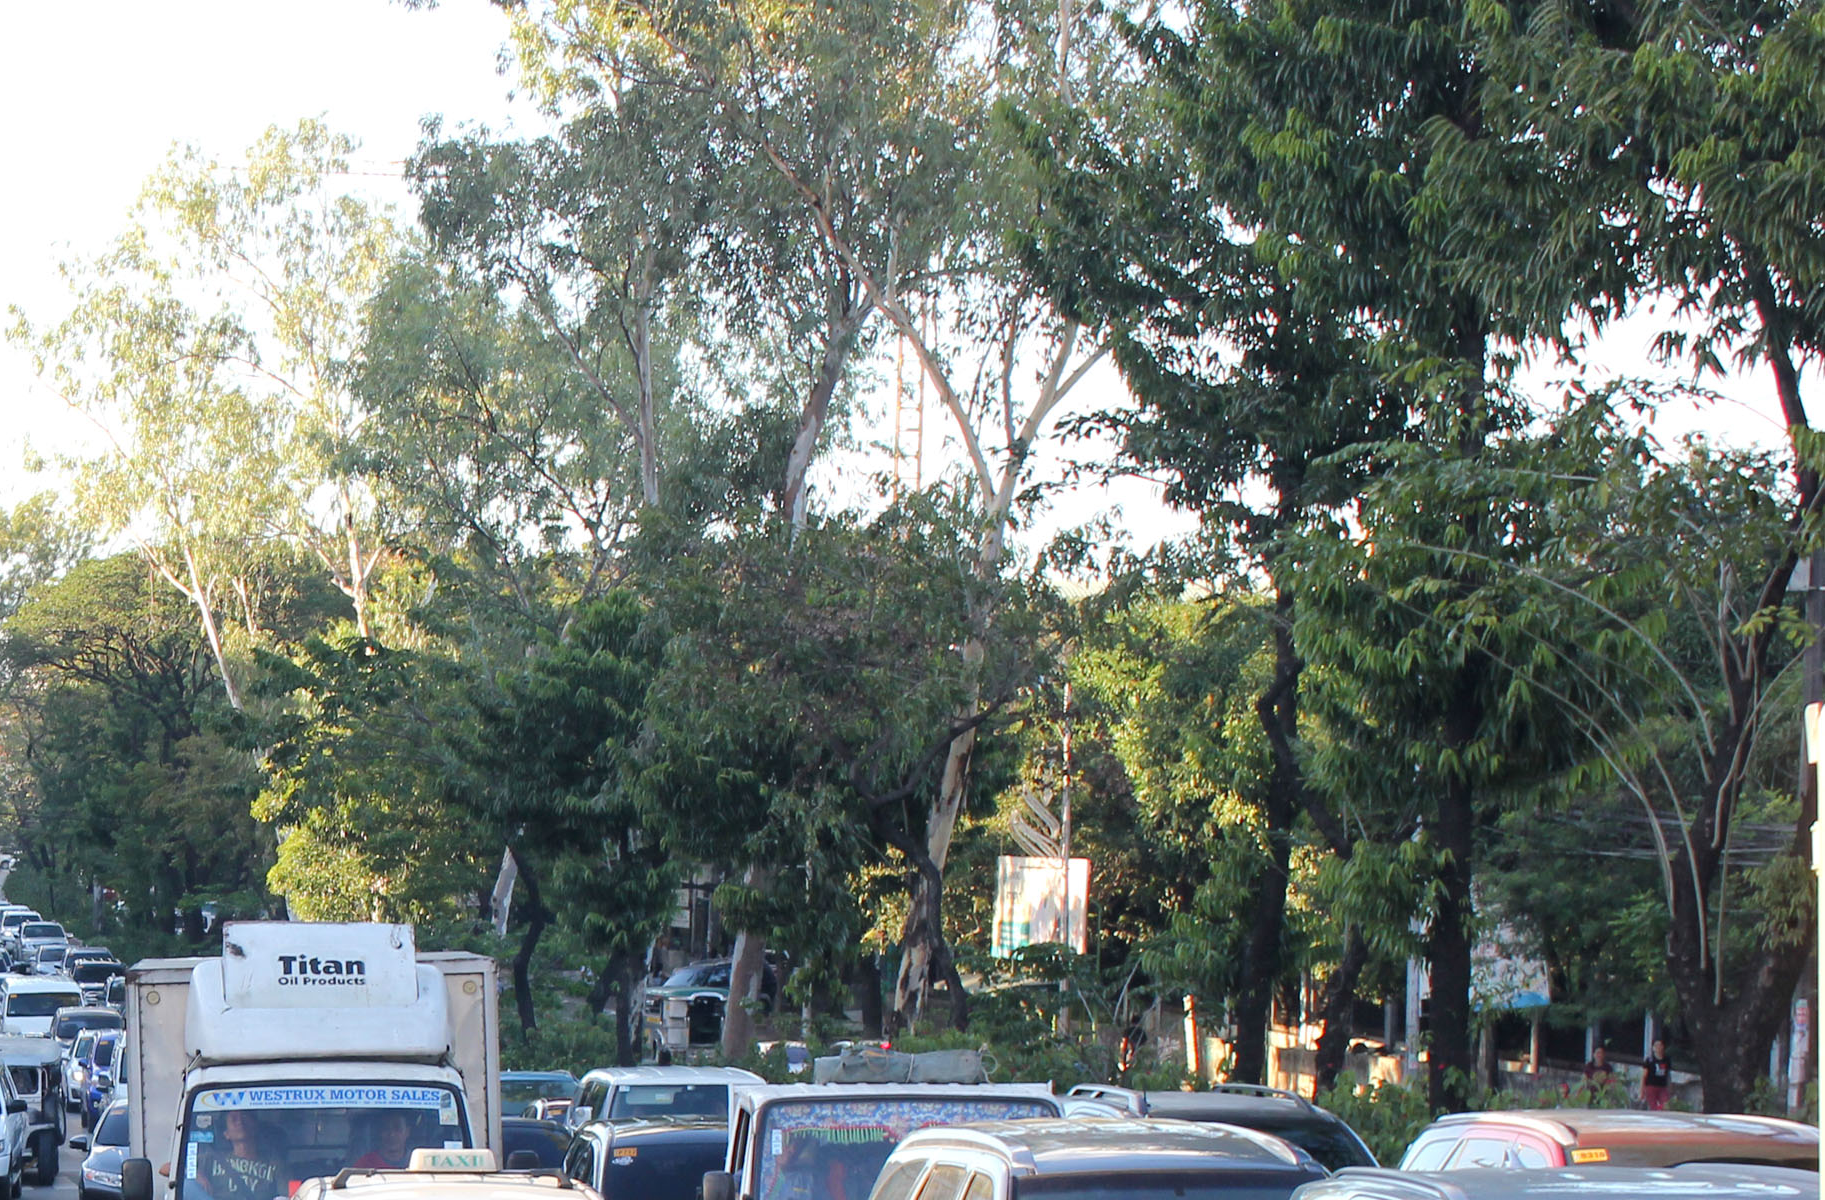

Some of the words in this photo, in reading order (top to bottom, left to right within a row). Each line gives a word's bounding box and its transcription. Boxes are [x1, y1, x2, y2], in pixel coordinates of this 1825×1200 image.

[278, 954, 365, 975] Titan
[278, 976, 298, 985] Oil
[303, 976, 365, 985] Products
[249, 1089, 325, 1101] WESTRUX
[330, 1089, 386, 1100] MOTOR
[391, 1090, 440, 1101] SALES
[429, 1155, 478, 1167] TAXI
